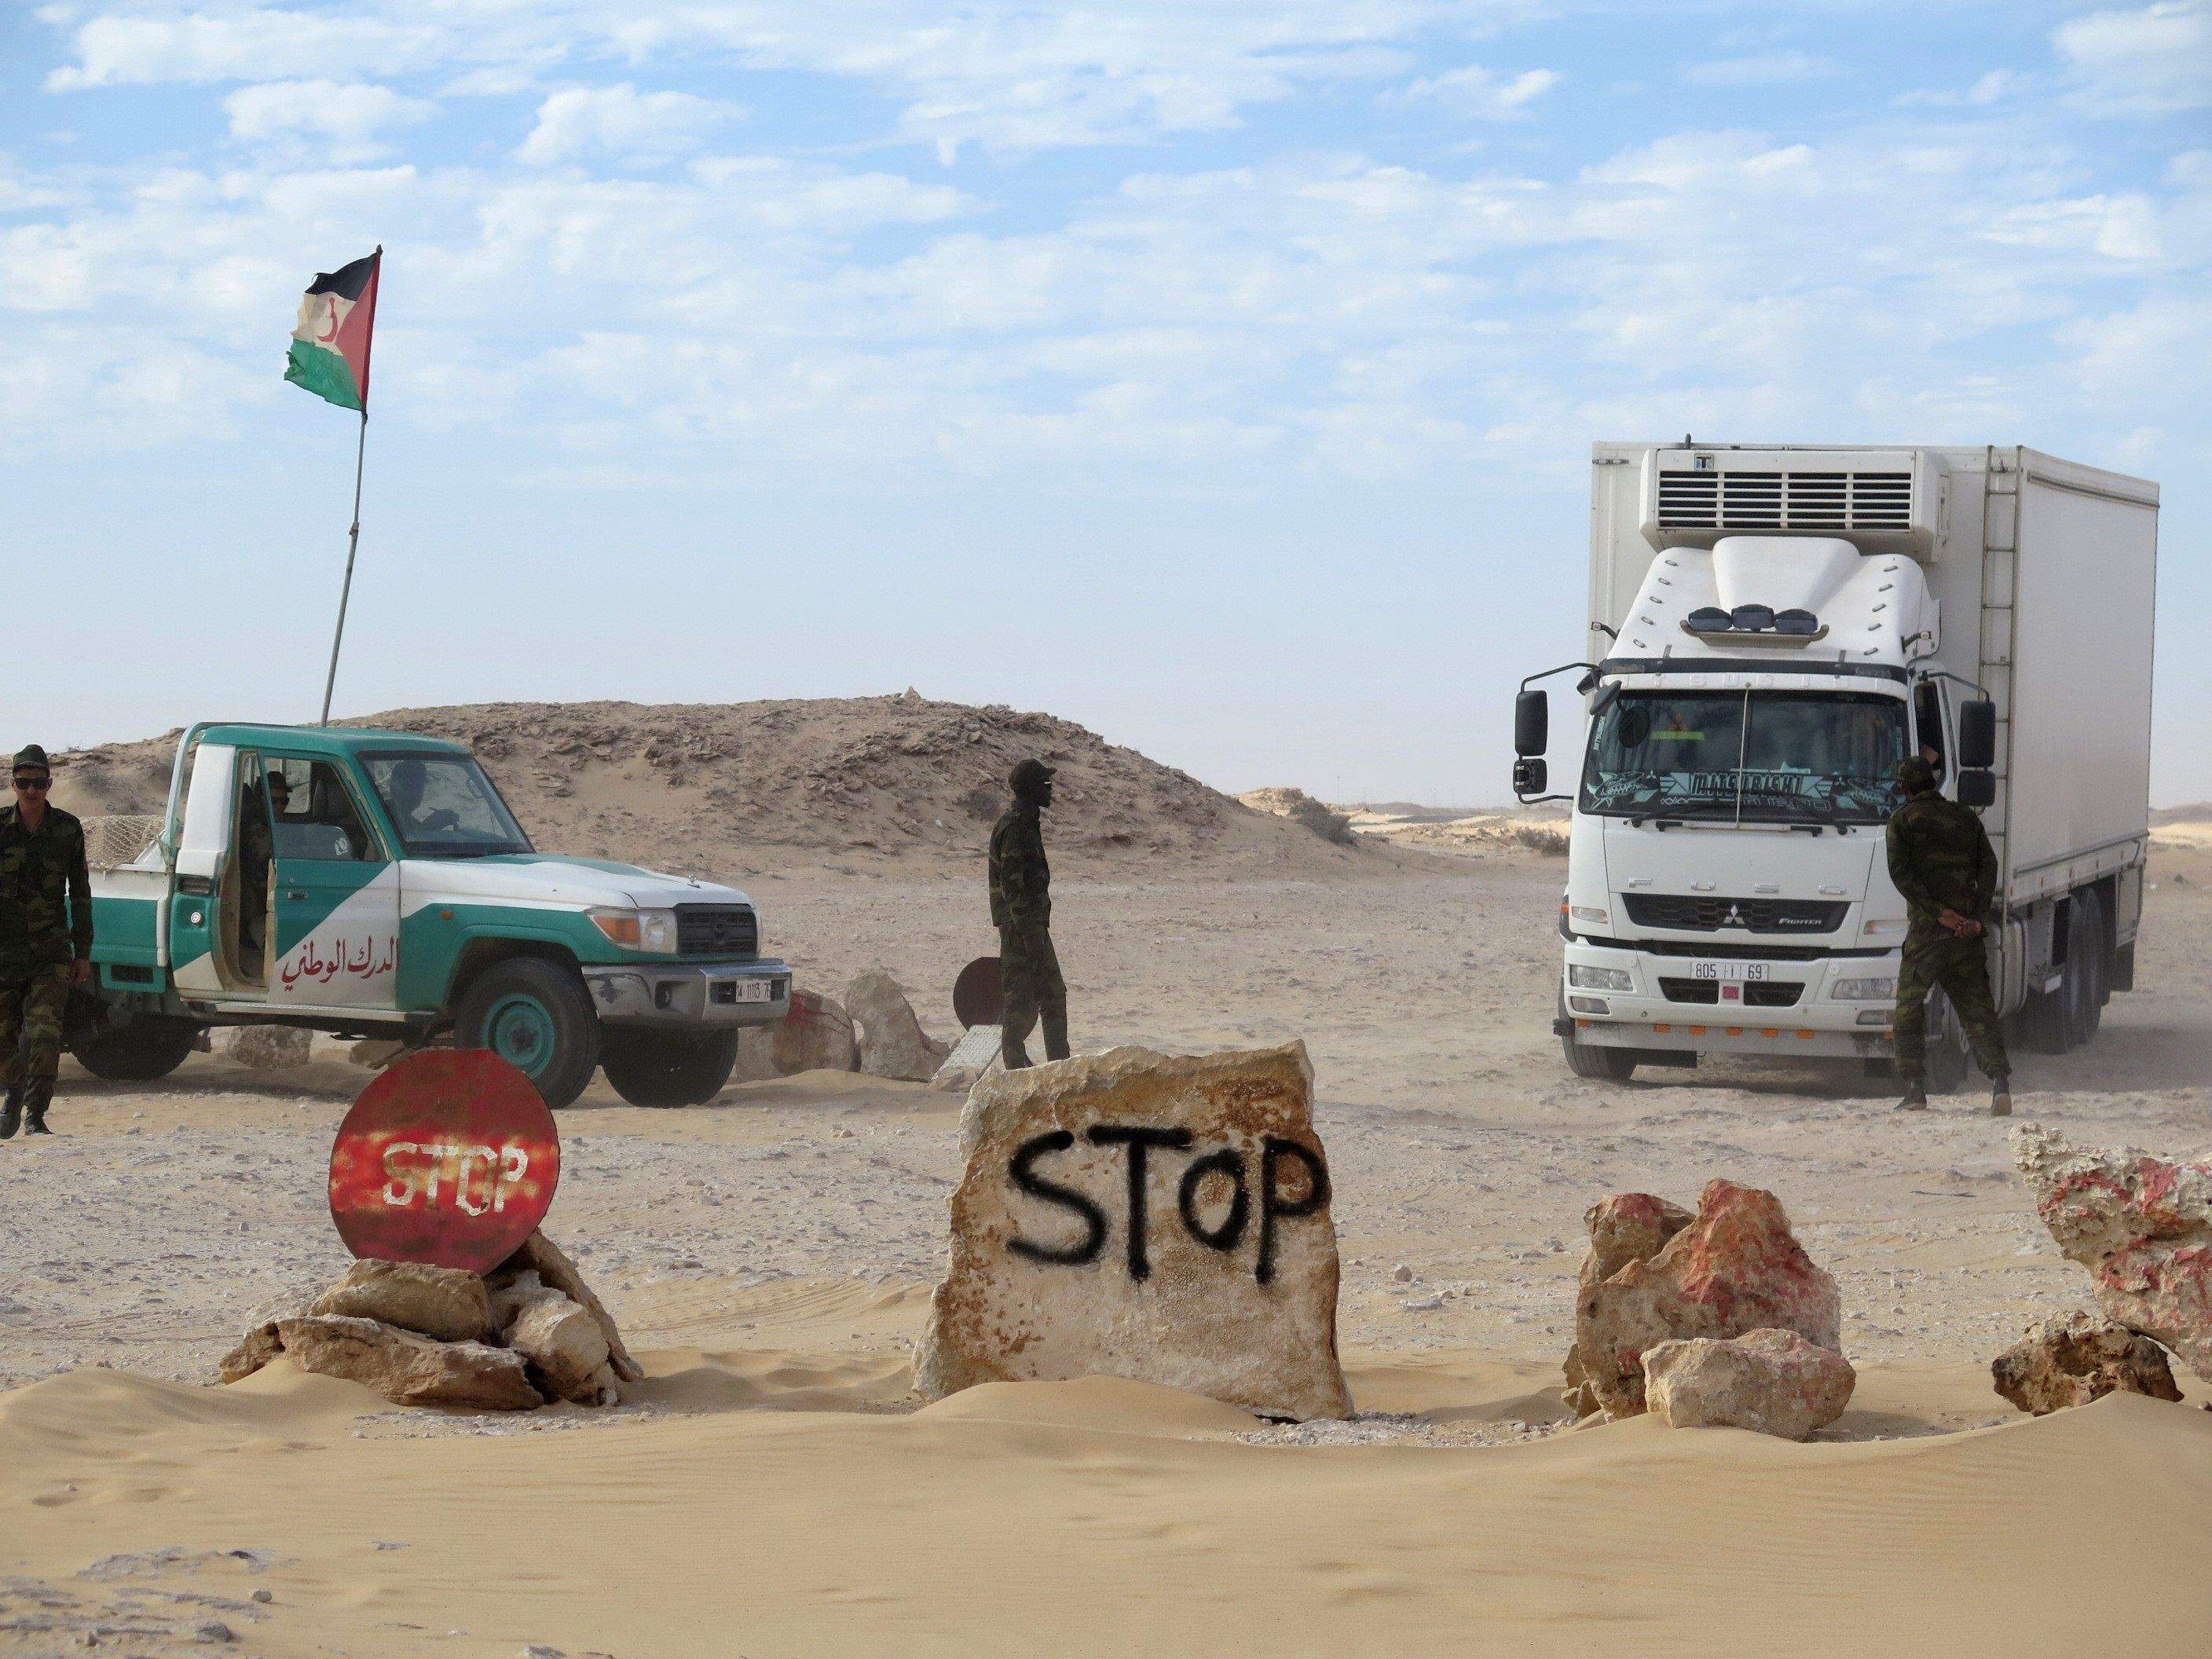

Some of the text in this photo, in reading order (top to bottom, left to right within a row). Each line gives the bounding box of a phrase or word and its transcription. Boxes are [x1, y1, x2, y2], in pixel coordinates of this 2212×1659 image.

[281, 938, 346, 992] الوطني
[1695, 963, 1717, 978] 805
[1748, 965, 1762, 980] 69
[382, 1141, 529, 1217] STOP
[1005, 1124, 1331, 1284] STOP
